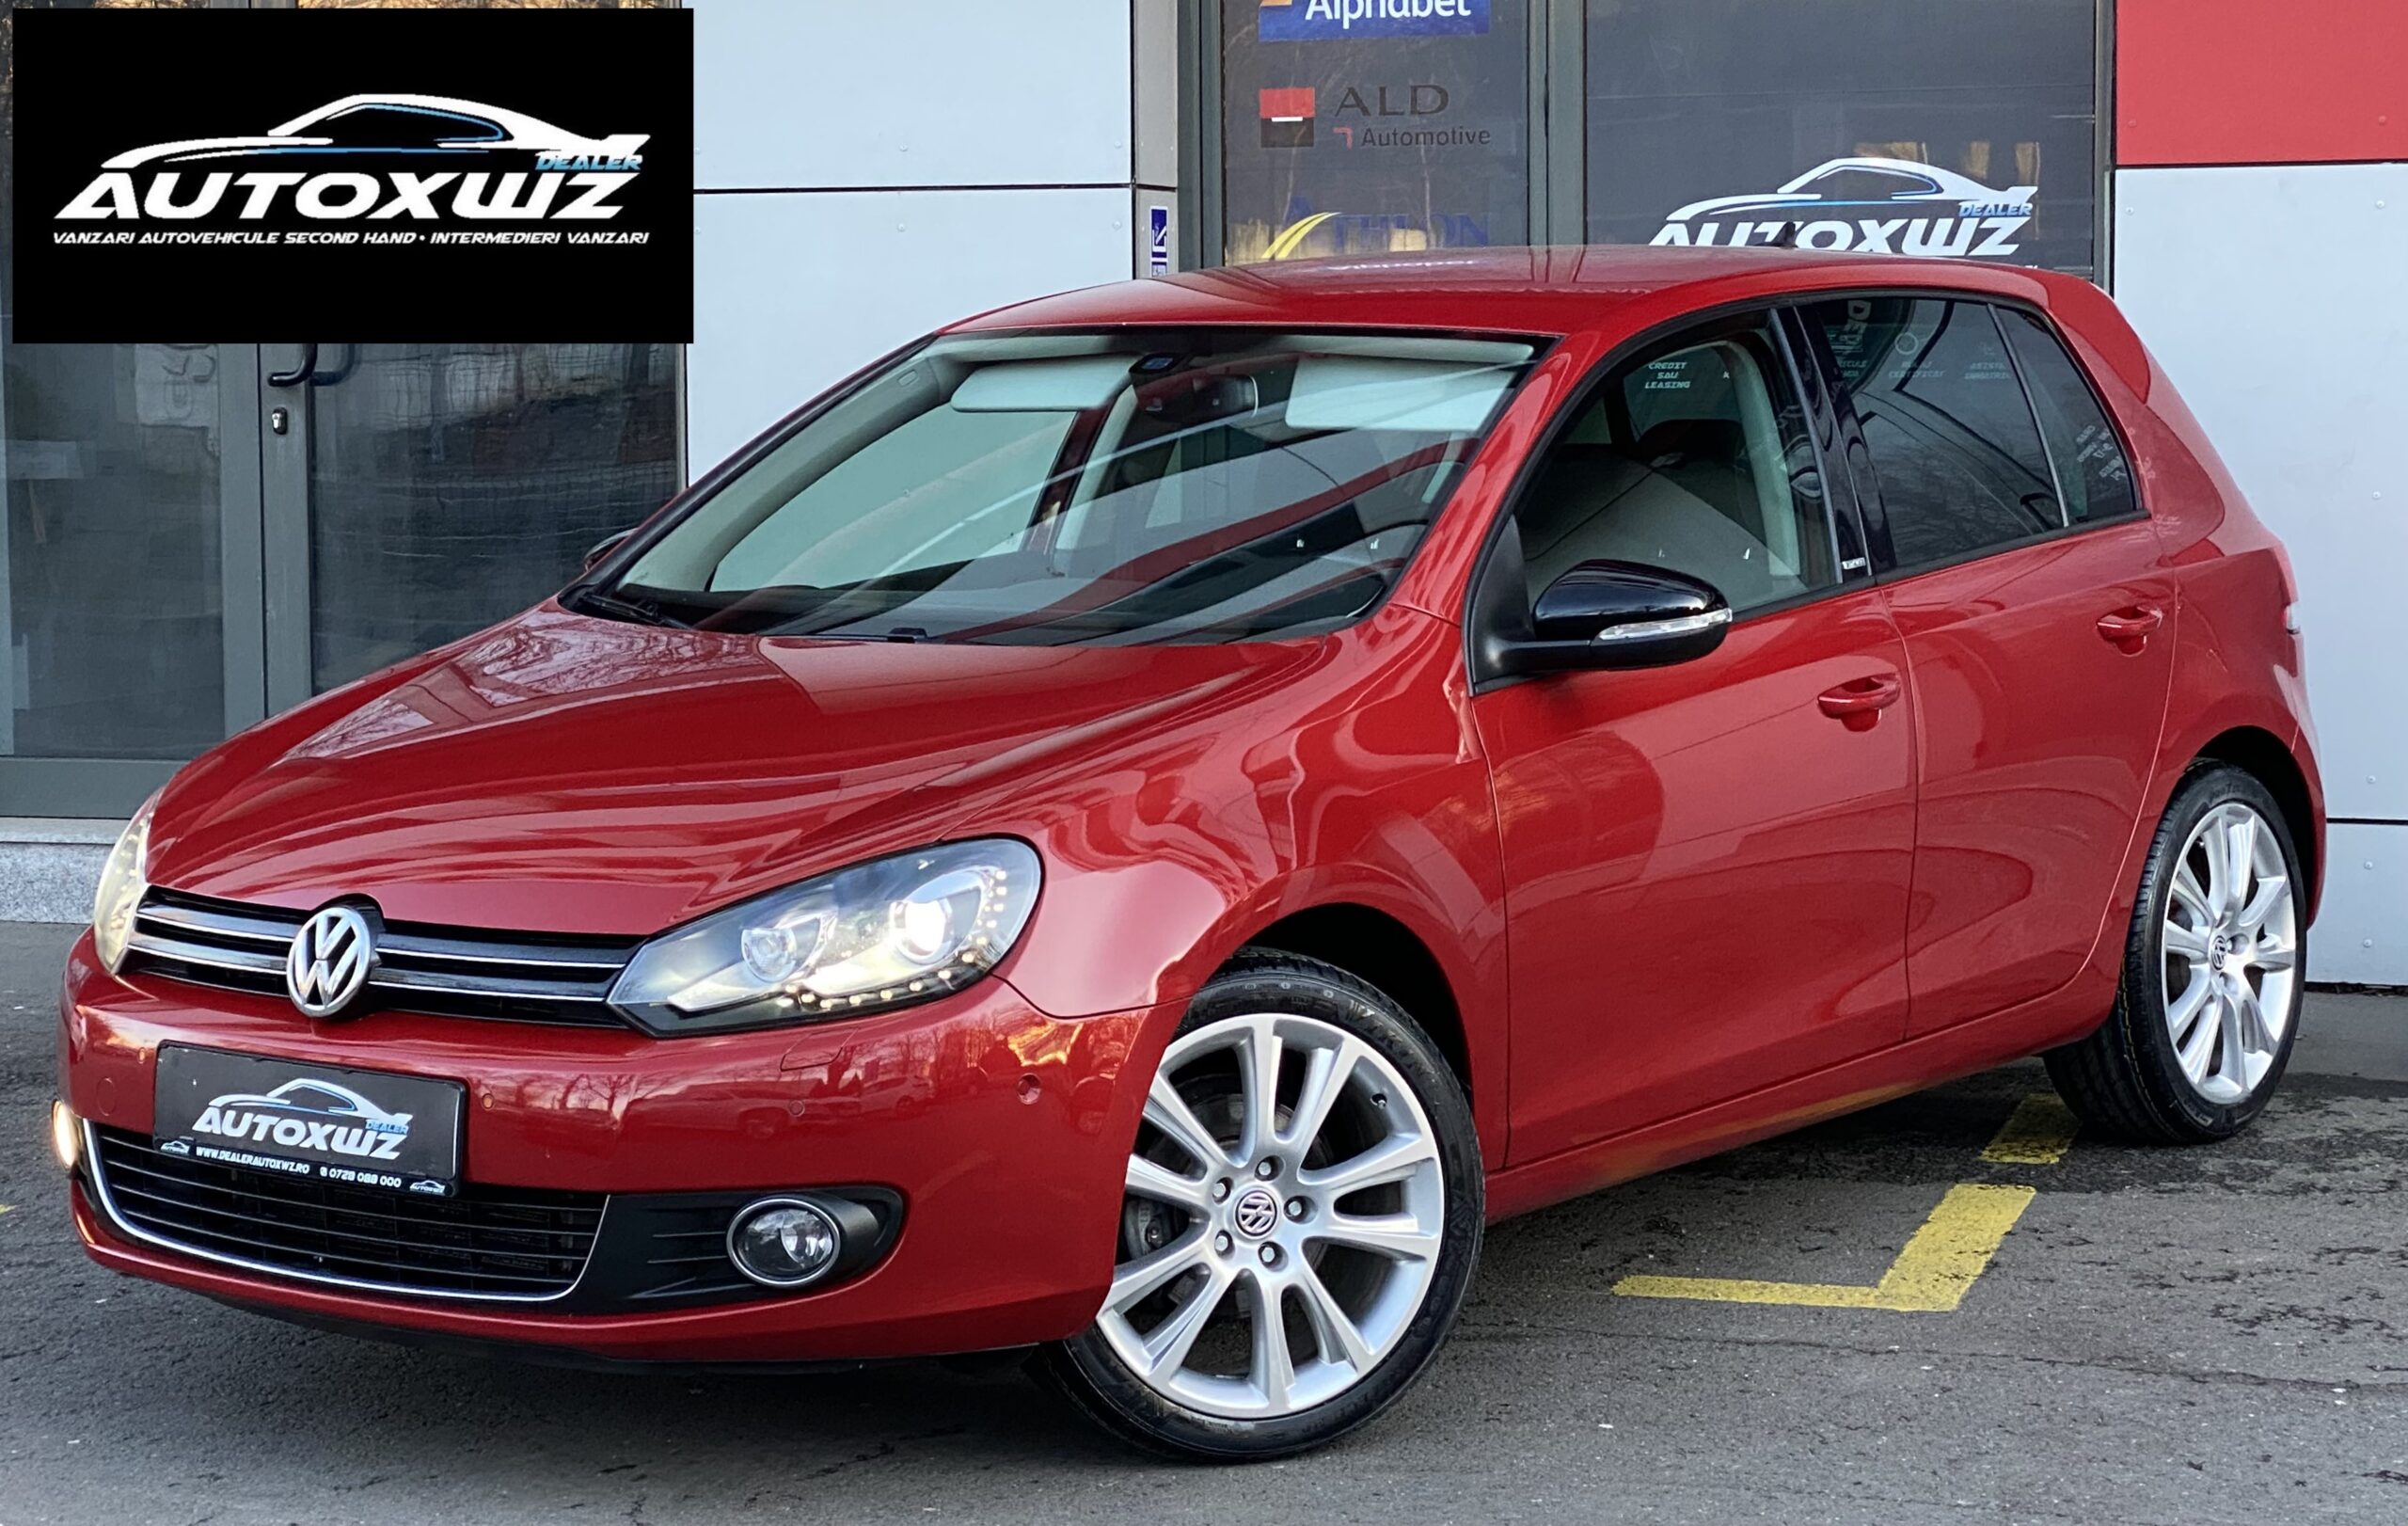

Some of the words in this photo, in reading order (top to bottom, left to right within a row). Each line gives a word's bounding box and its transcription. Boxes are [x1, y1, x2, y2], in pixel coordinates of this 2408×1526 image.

[1335, 85, 1450, 118] ALD
[1361, 126, 1492, 148] Automotive
[1958, 200, 2033, 217] DEALER
[1648, 361, 1687, 370] CREDIT
[1644, 381, 1691, 389] LEASING
[365, 1120, 408, 1136] DEALER
[196, 1146, 310, 1174] WWW.DEALERAUTOXWZ.RO
[379, 1175, 402, 1188] 000
